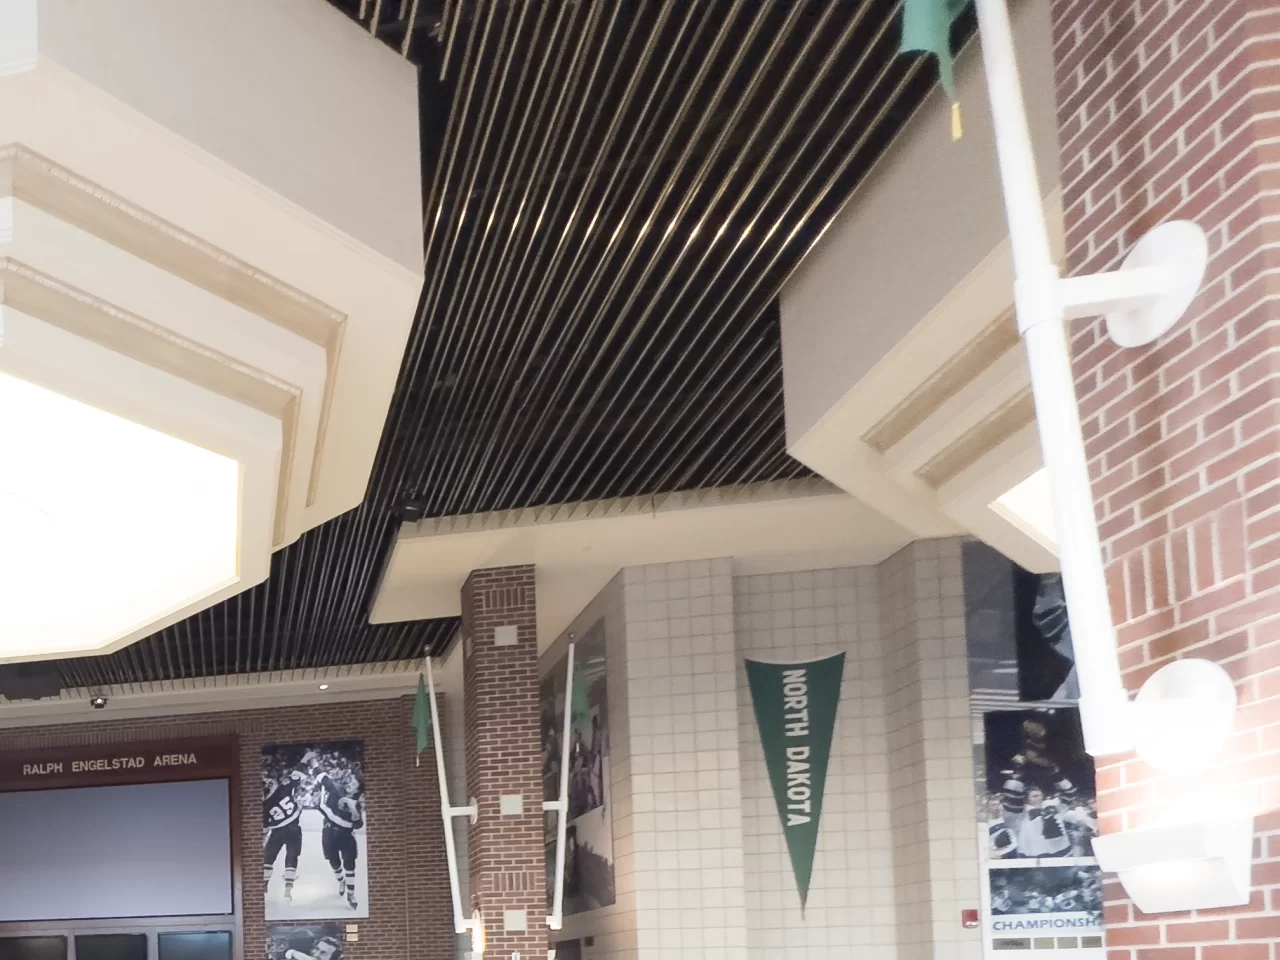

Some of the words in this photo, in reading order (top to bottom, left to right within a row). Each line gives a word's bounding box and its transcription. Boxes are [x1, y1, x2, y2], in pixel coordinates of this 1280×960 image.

[782, 669, 809, 736] NORTH
[23, 763, 63, 775] RALPH
[72, 757, 145, 772] ENGELSTAD
[153, 753, 197, 766] ARENA
[786, 746, 811, 826] DAKOTA
